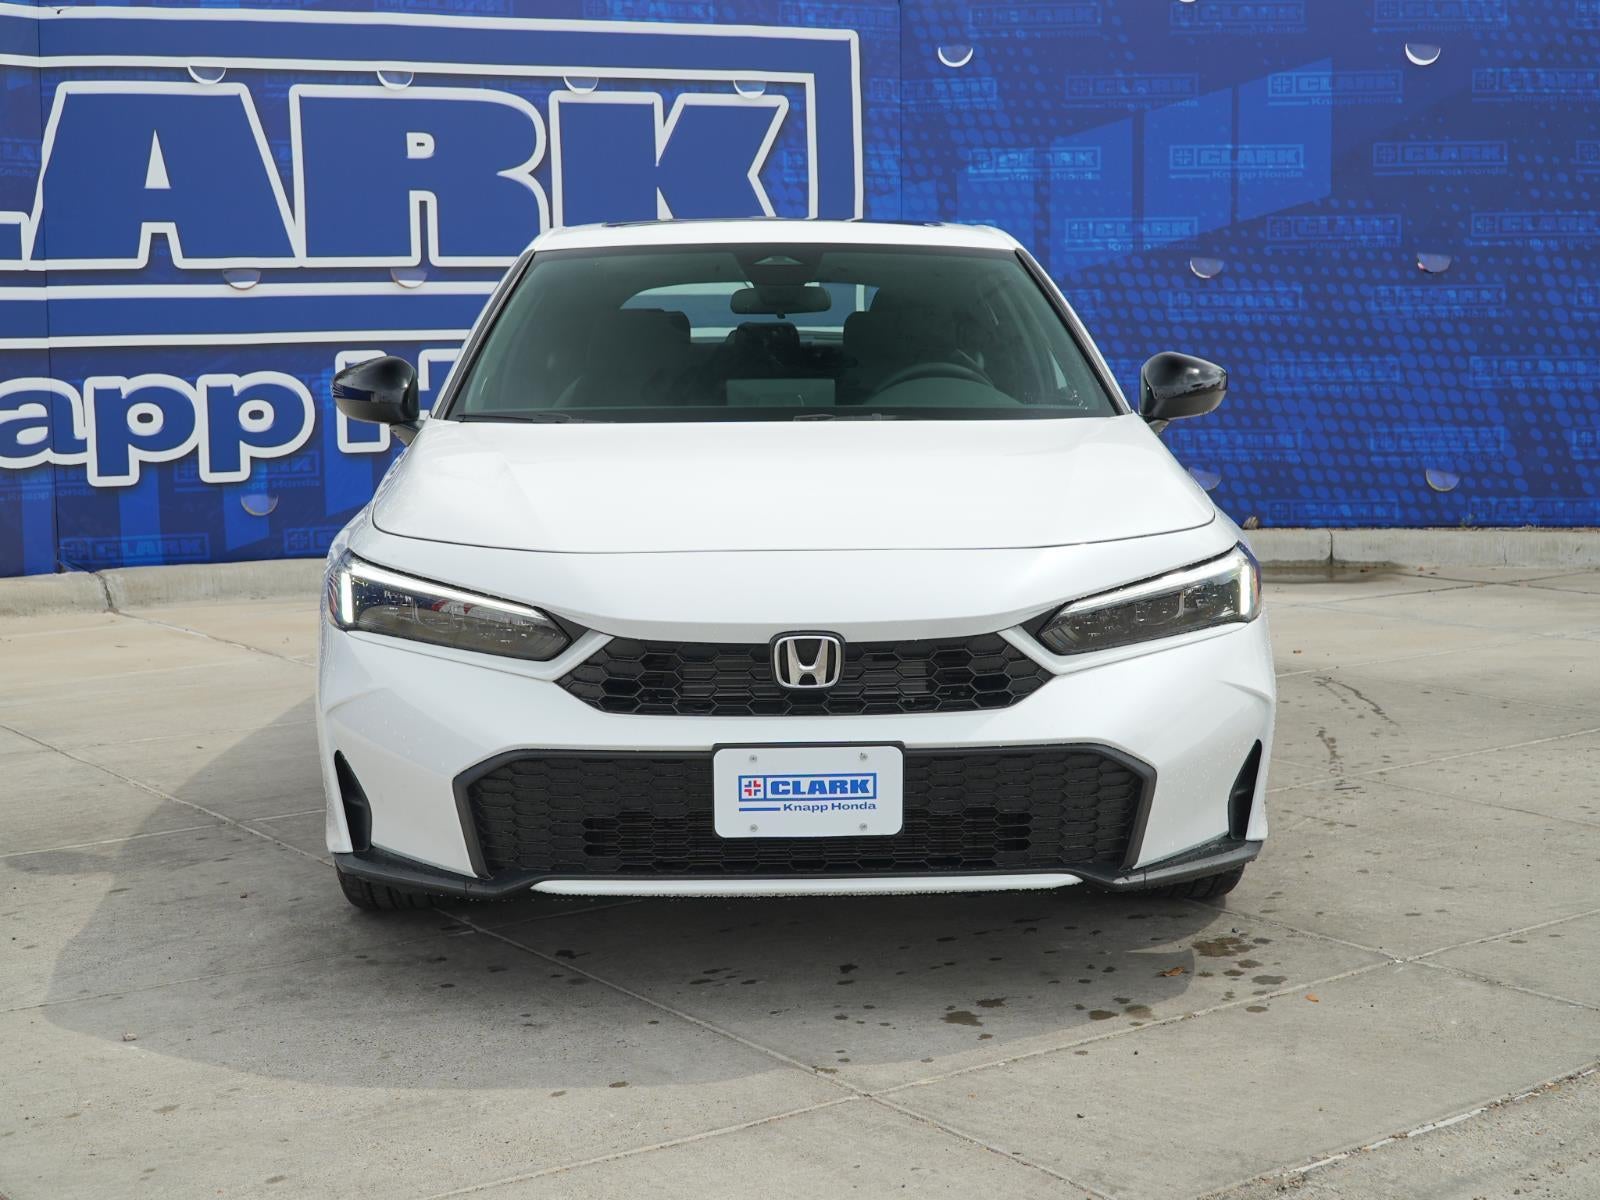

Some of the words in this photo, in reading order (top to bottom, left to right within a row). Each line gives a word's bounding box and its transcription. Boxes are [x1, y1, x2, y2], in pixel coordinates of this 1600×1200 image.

[770, 778, 870, 795] CLARK
[783, 803, 829, 813] Knapp
[831, 801, 877, 811] Honda
